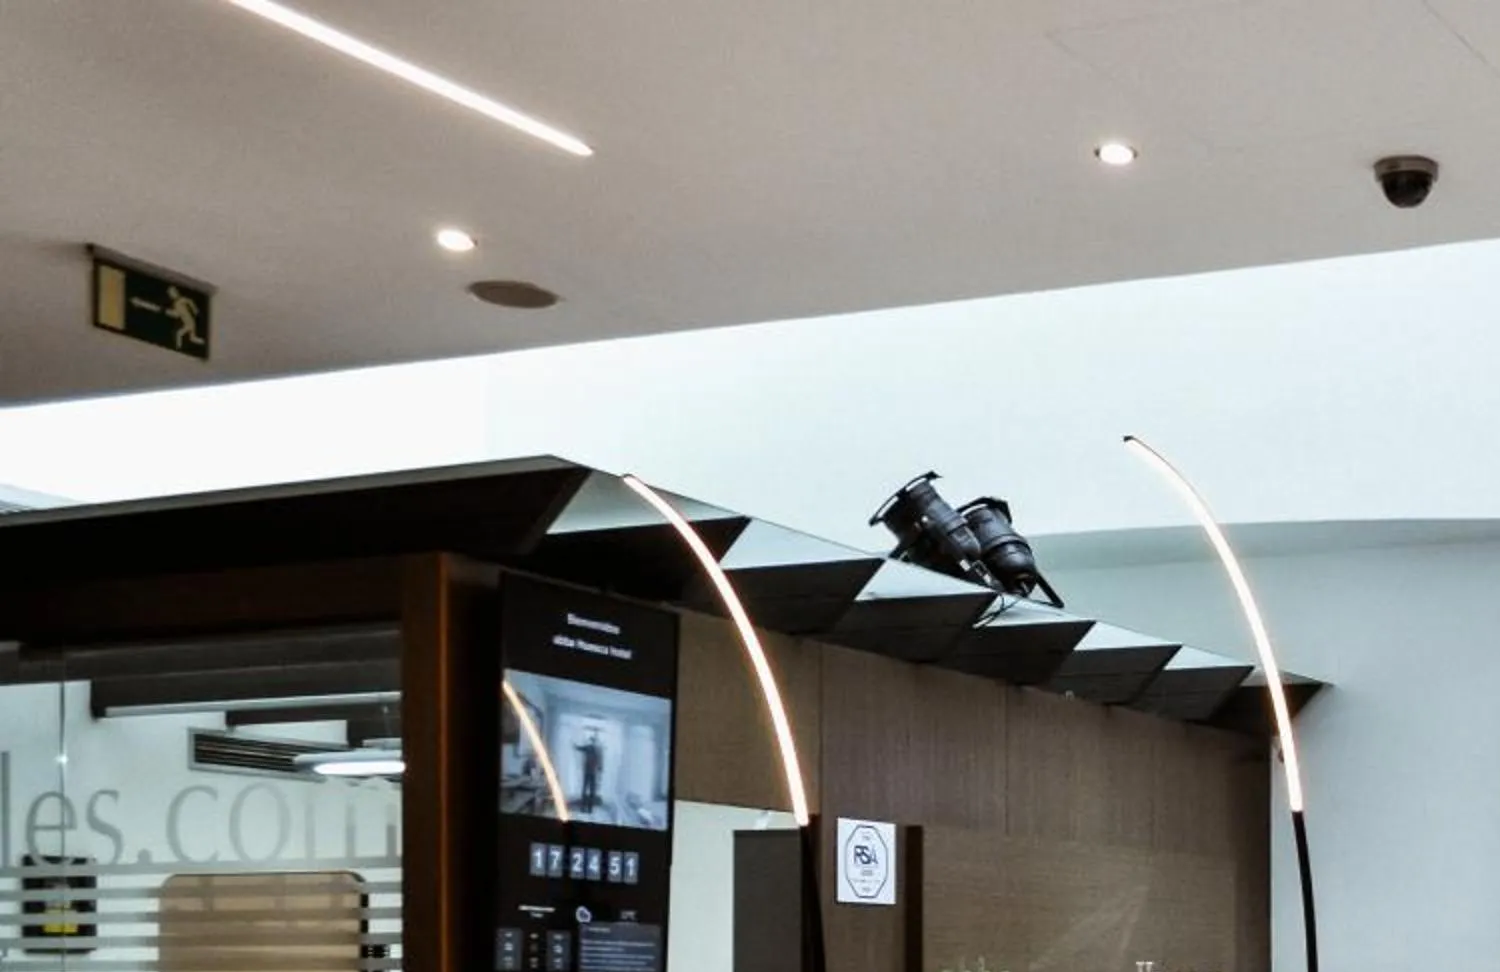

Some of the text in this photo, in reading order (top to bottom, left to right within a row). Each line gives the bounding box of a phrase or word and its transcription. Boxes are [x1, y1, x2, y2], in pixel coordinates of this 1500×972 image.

[532, 849, 633, 876] 17 24 51
